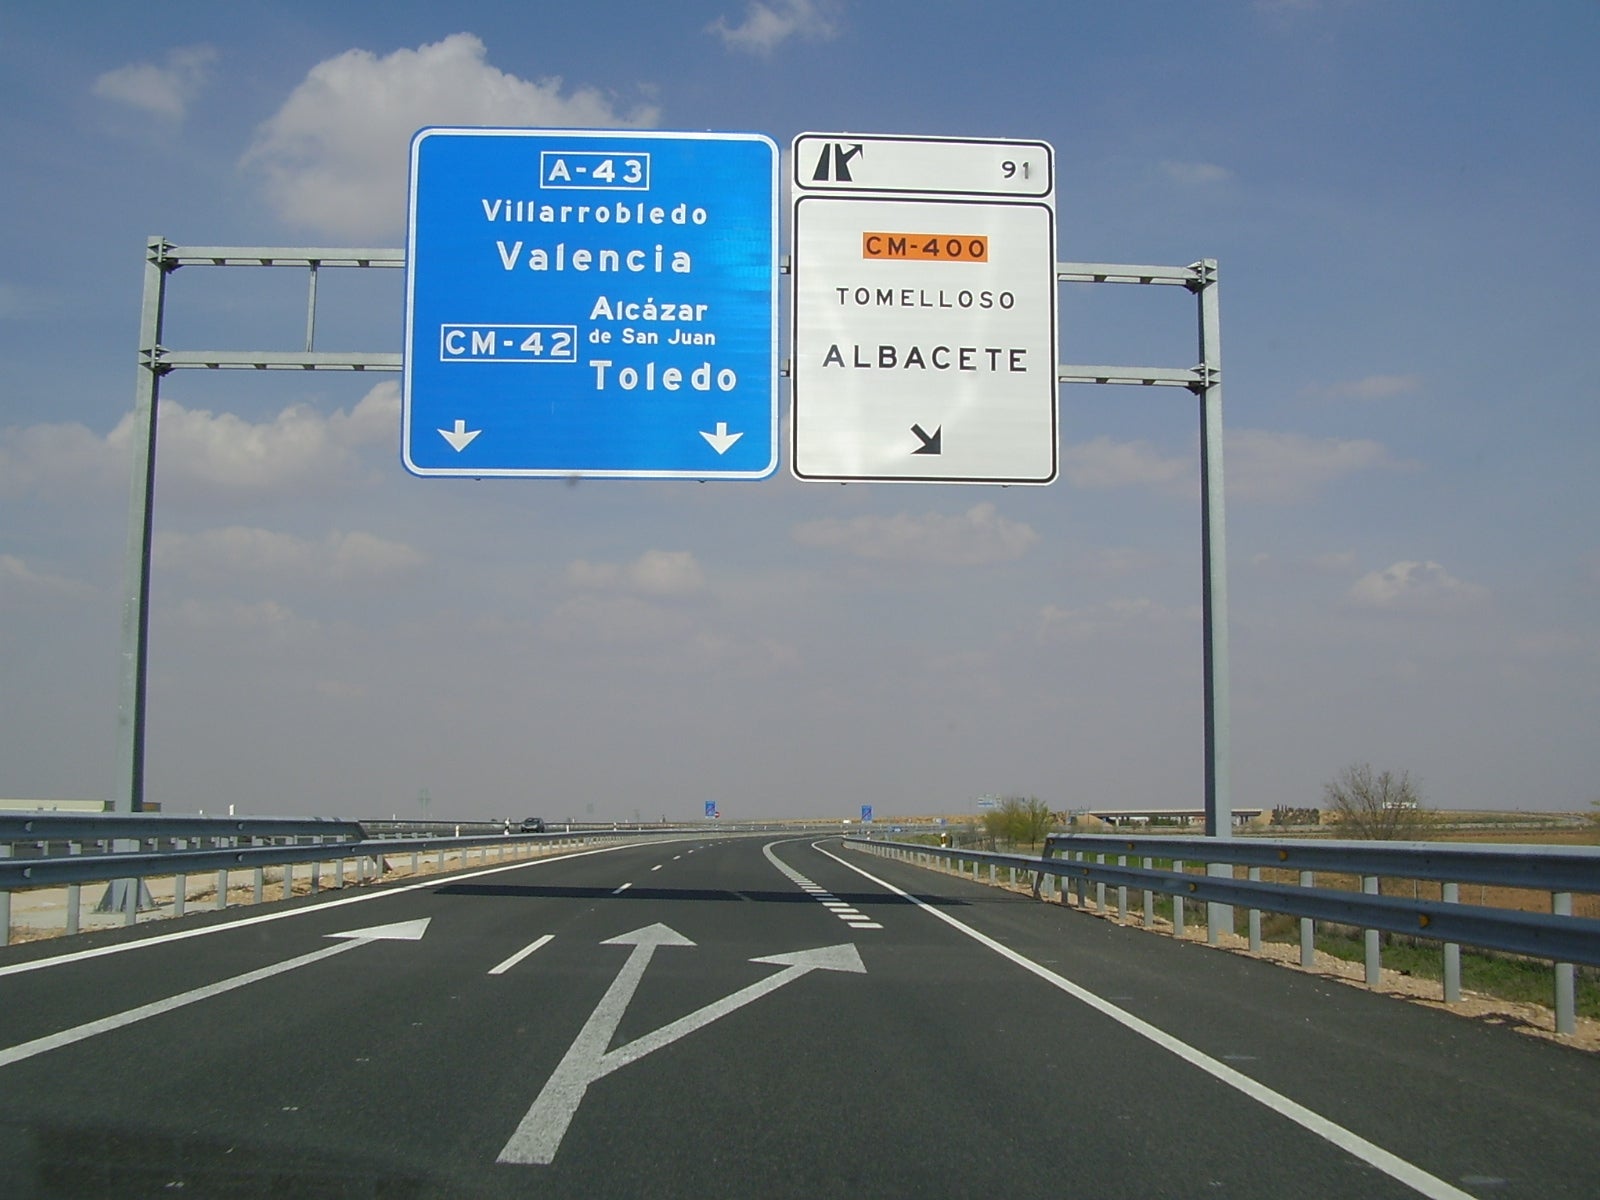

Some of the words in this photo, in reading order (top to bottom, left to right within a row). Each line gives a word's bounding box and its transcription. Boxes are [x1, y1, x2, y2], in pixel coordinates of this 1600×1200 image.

[548, 158, 642, 183] A-43
[1001, 161, 1030, 180] 91
[482, 199, 707, 225] Villarrobledo
[497, 241, 691, 273] Valencia
[866, 236, 985, 258] CM-400
[589, 296, 708, 321] Alcázar
[836, 287, 1015, 310] TOMELLOSO
[445, 330, 571, 356] CM-42
[588, 328, 612, 344] de
[621, 328, 659, 345] San
[667, 328, 716, 346] Juan
[822, 344, 1027, 372] ALBACETE
[589, 360, 737, 391] Toledo
